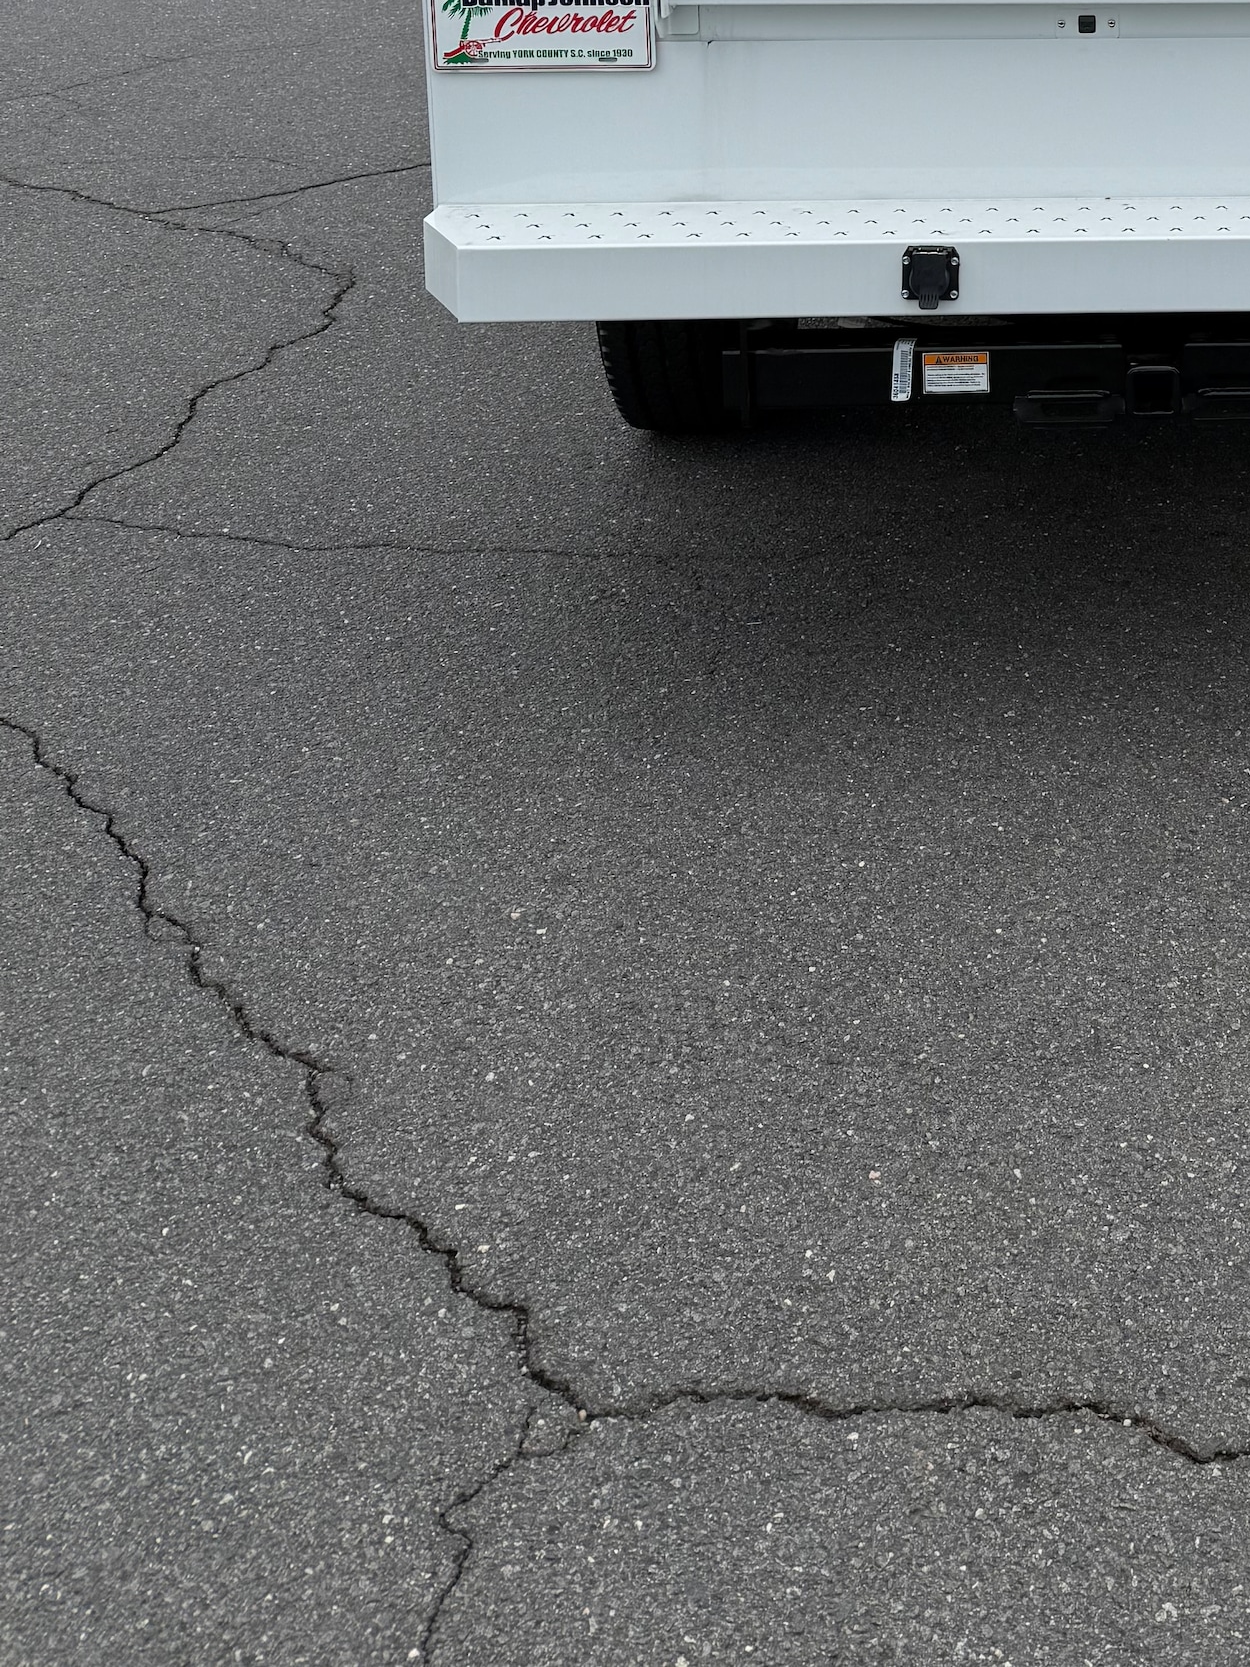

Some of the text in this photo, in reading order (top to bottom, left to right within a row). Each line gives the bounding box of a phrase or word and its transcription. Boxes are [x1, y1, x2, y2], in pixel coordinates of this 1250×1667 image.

[494, 7, 637, 42] Chevrolet
[478, 49, 511, 59] Serving
[512, 49, 535, 58] YORK
[536, 49, 569, 58] COUNTY
[570, 49, 586, 58] S.C.
[587, 49, 611, 58] since
[942, 355, 979, 363] WARNING
